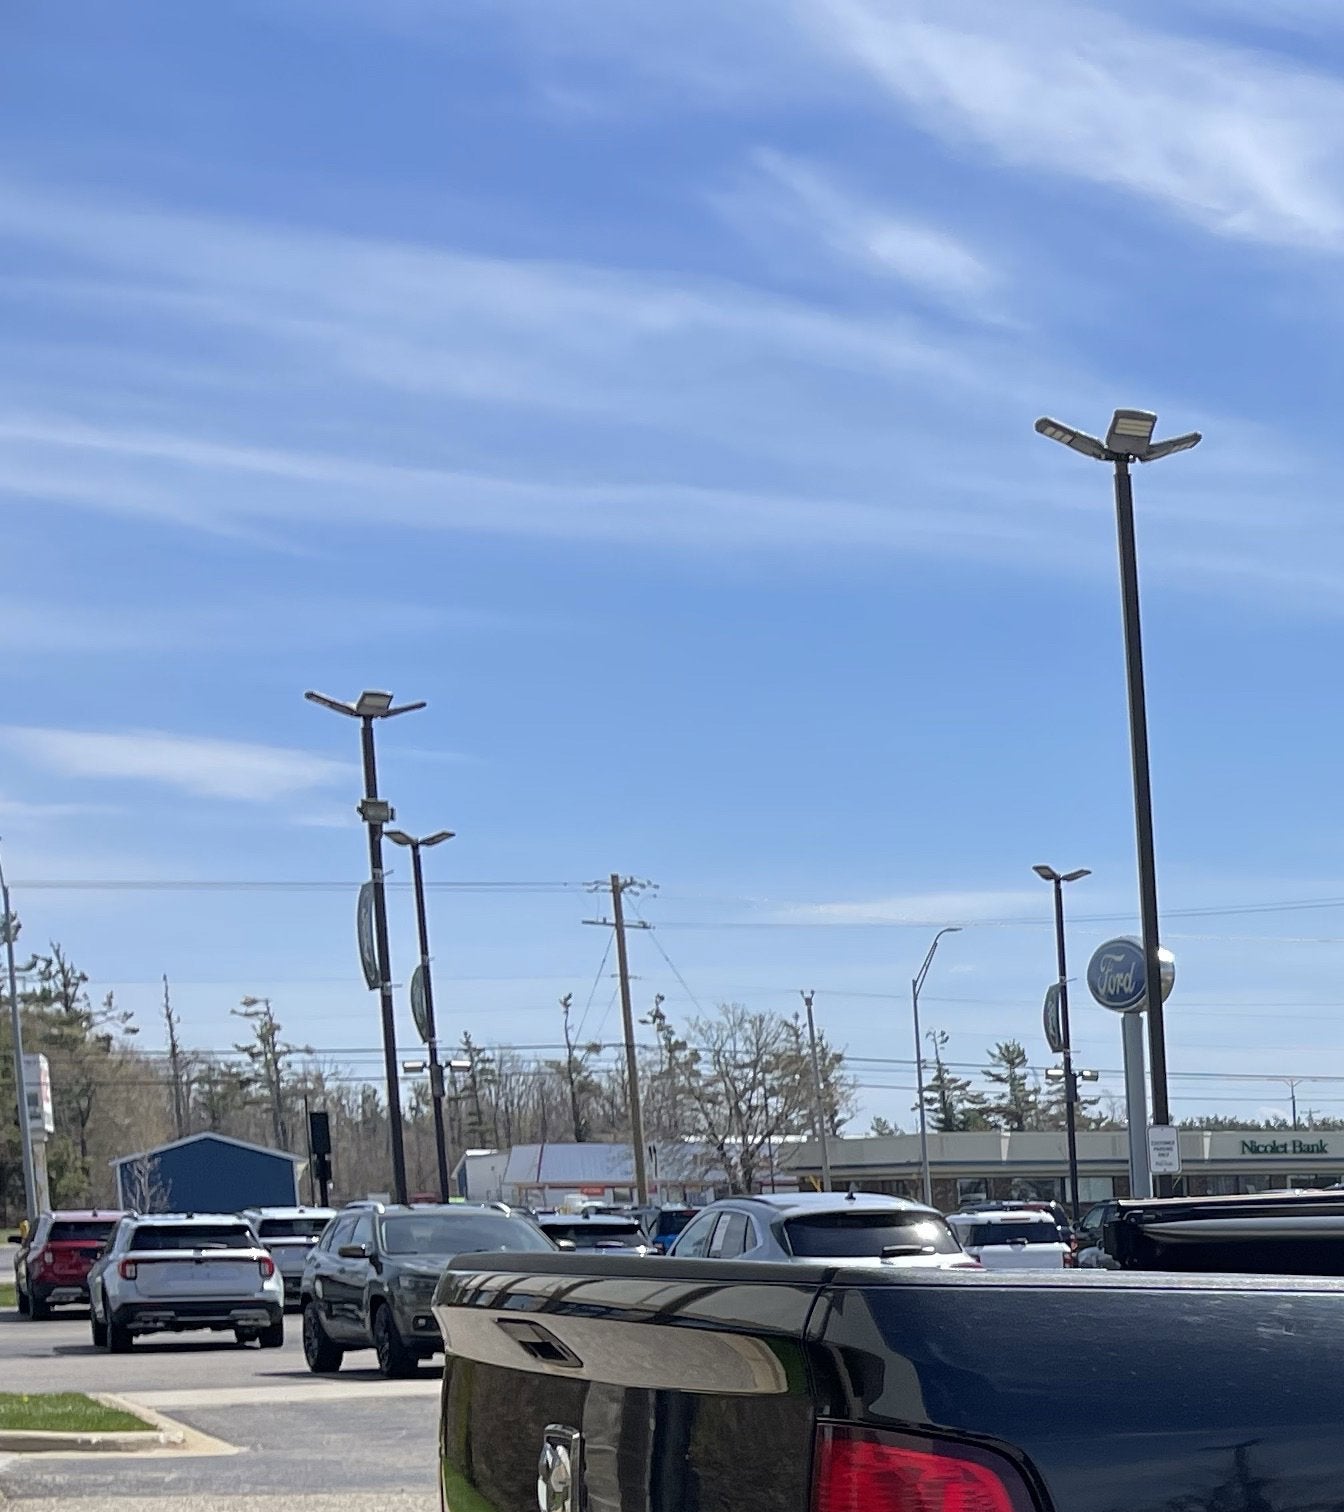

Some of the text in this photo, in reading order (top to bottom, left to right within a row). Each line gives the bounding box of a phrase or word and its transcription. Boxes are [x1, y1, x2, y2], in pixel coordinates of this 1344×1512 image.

[1098, 953, 1136, 996] Ford
[1241, 1139, 1328, 1155] Nicolet Bank
